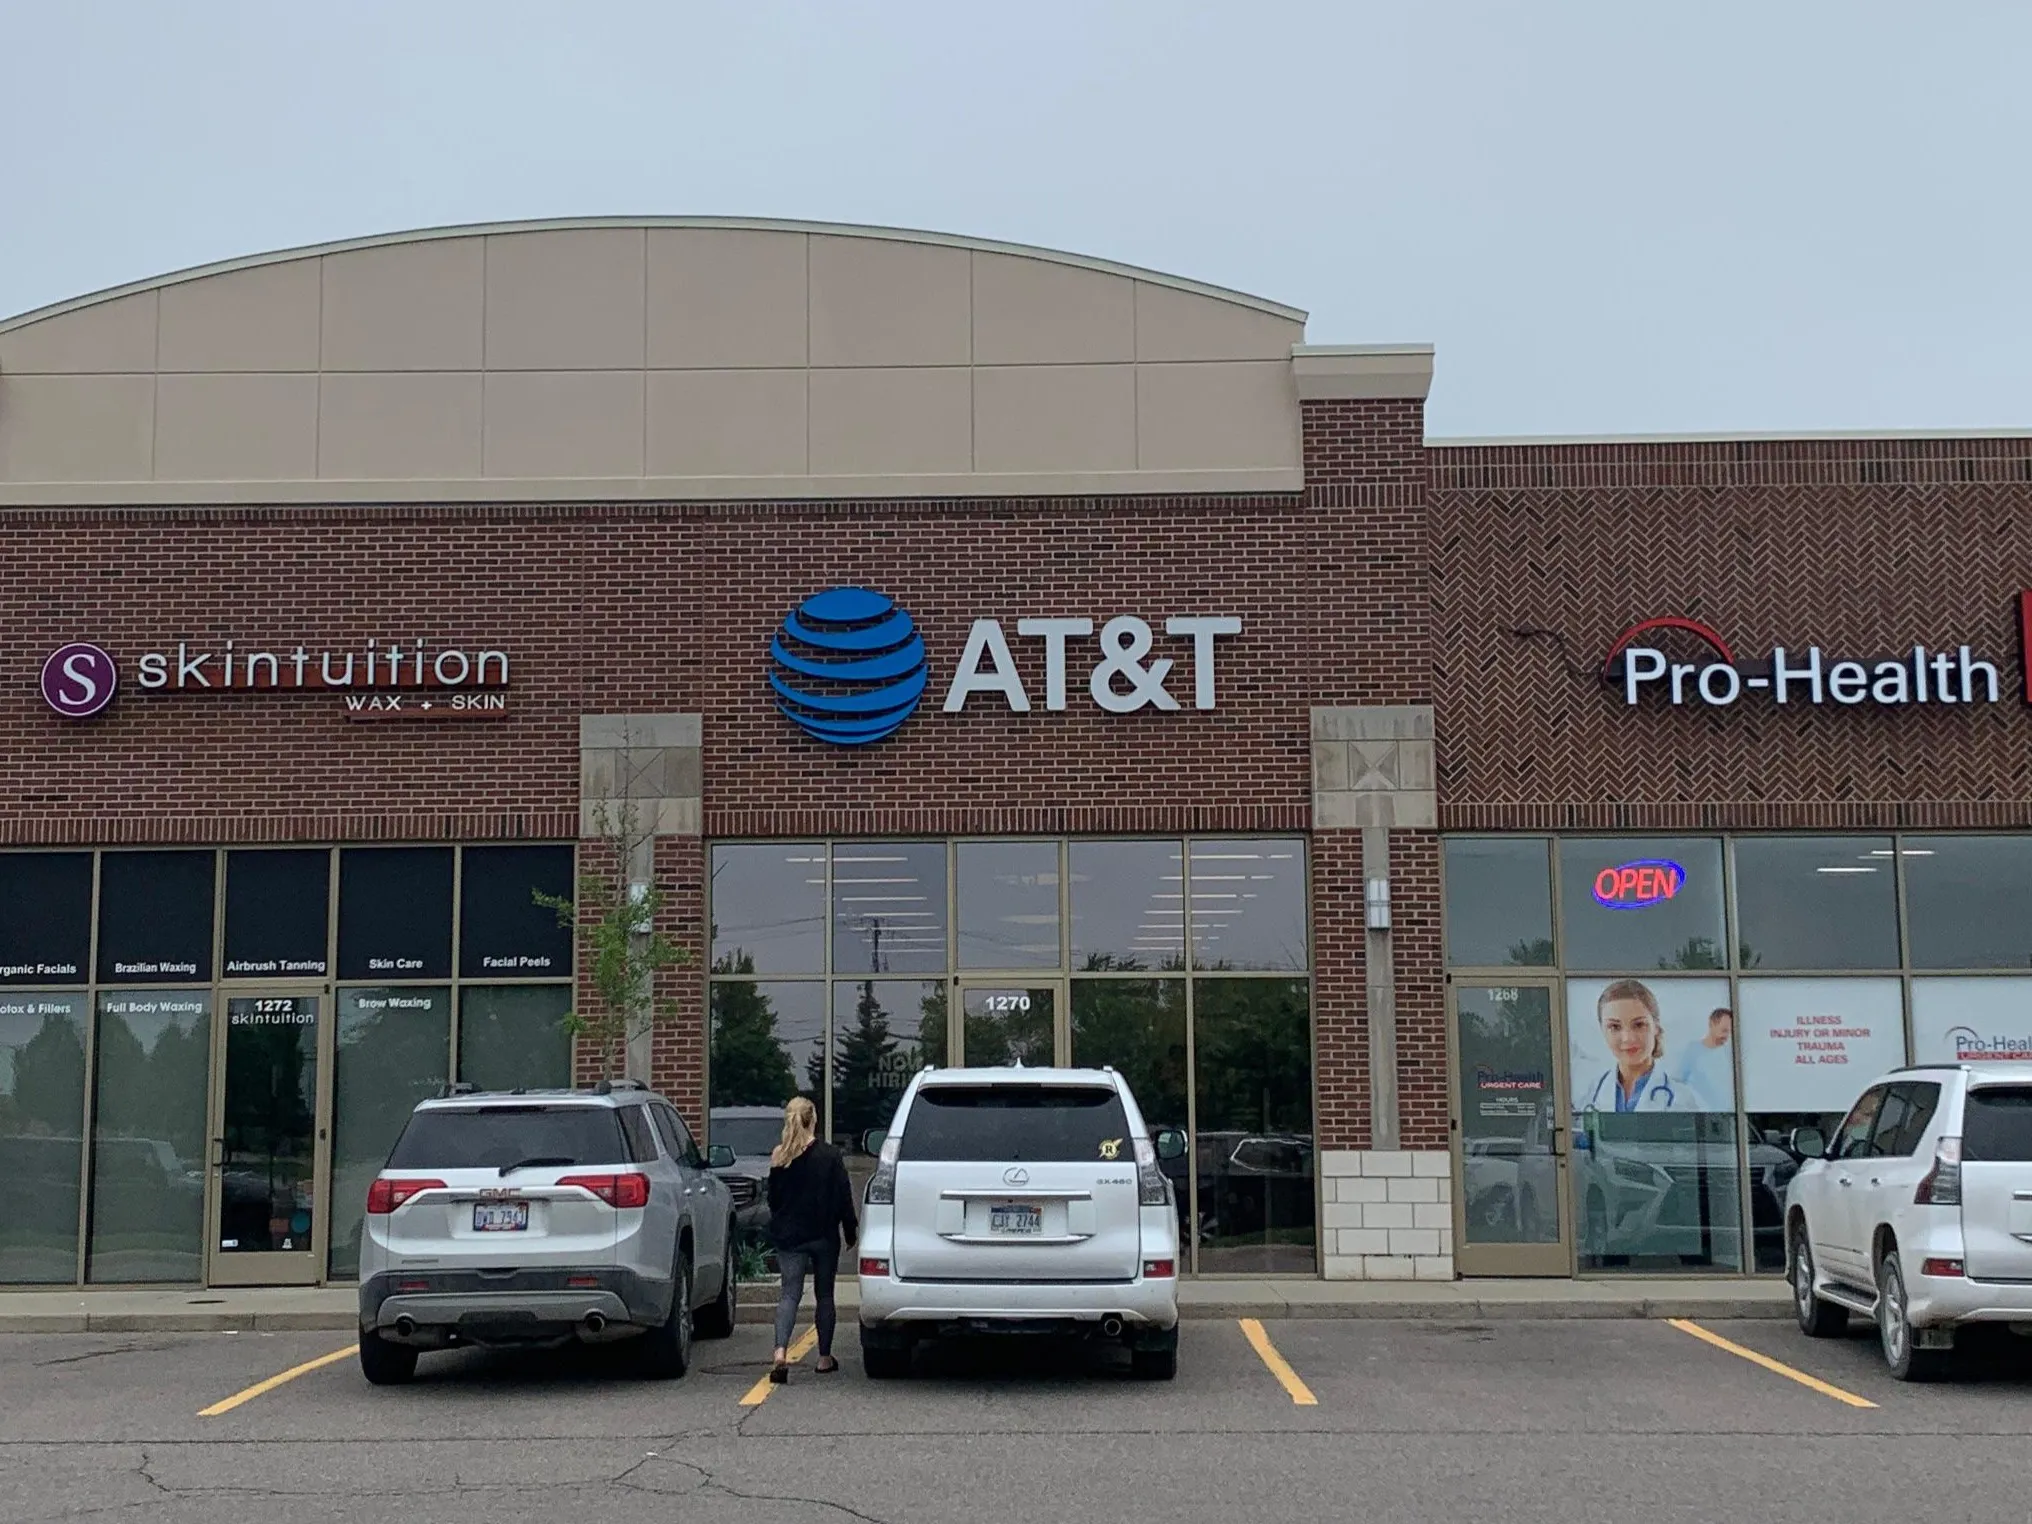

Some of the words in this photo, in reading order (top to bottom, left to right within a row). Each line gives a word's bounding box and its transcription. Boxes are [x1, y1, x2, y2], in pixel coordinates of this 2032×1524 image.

[137, 638, 509, 688] skintuition
[943, 615, 1242, 713] AT&T
[58, 652, 97, 706] S
[1624, 645, 2000, 705] Pro-Health
[345, 696, 401, 712] WAX
[451, 694, 505, 711] SKIN
[1594, 867, 1676, 899] OPEN
[114, 962, 158, 974] Brazilian
[160, 961, 197, 975] Waxing
[227, 960, 277, 972] Airbrush
[279, 960, 326, 973] Tanning
[369, 958, 394, 969] Skin
[396, 958, 423, 969] Care
[483, 956, 517, 968] Facial
[520, 956, 551, 968] Peels
[36, 963, 77, 975] Facials
[1488, 987, 1518, 1001] 1268
[0, 1003, 24, 1014] otox
[27, 1004, 35, 1014] &
[38, 1003, 72, 1014] Fillers
[106, 1002, 126, 1013] Full
[128, 1002, 157, 1014] Body
[159, 1001, 203, 1014] Waxing
[254, 1000, 293, 1012] 1272
[358, 998, 387, 1009] Brow
[389, 997, 432, 1010] Waxing
[986, 996, 1031, 1011] 1270
[231, 1012, 315, 1025] skintuition
[1796, 1015, 1842, 1025] ILLNESS
[1769, 1028, 1810, 1038] INJURY
[1813, 1028, 1830, 1038] OR
[1832, 1028, 1871, 1038] MINOR
[1797, 1041, 1846, 1051] TRAUMA
[1955, 1035, 2032, 1052] Pro-Heal
[1795, 1055, 1816, 1064] ALL
[1818, 1055, 1849, 1064] AGES
[868, 1071, 912, 1088] HIRI
[1105, 1145, 1114, 1154] R
[479, 1187, 522, 1198] GMC
